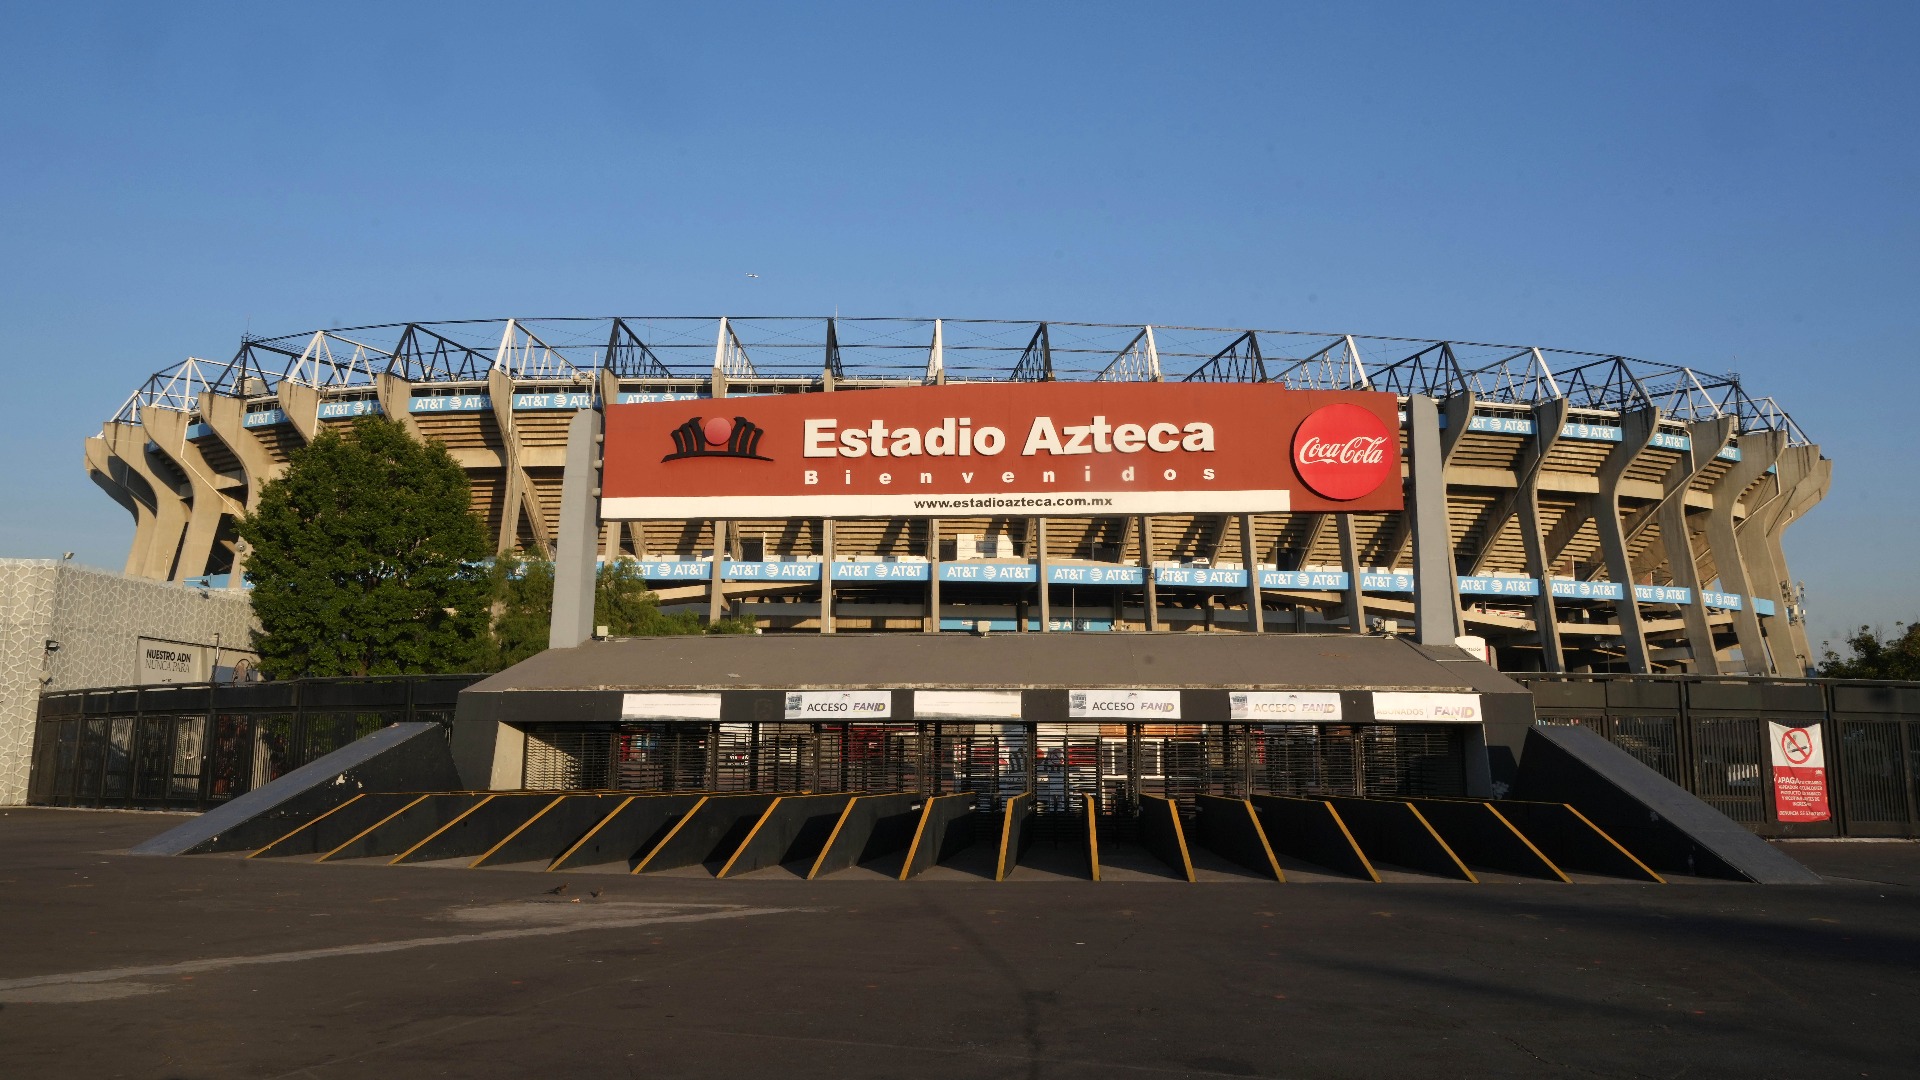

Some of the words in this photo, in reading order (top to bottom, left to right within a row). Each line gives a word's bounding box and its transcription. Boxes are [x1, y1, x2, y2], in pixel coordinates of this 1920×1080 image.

[415, 398, 446, 410] AT&T
[518, 395, 549, 407] AT&T
[323, 402, 351, 416] AT&T
[247, 412, 270, 425] AT&T
[1469, 418, 1487, 429] &T
[1504, 419, 1531, 432] AT&T
[803, 417, 1006, 458] Estadio
[1021, 415, 1215, 456] Azteca
[1561, 424, 1575, 436] &T
[1590, 427, 1615, 439] AT&T
[1665, 435, 1685, 448] AT&T
[1299, 436, 1388, 464] Coca-Cola
[1722, 447, 1737, 458] AT&T
[804, 465, 1215, 485] Bienvenidos
[914, 497, 1113, 509] www.estadioazteca.com.mx
[673, 563, 706, 576] AT&T
[728, 564, 761, 576] AT&T
[781, 564, 814, 577] AT&T
[838, 564, 870, 577] AT&T
[891, 564, 923, 577] AT&T
[947, 566, 980, 578] AT&T
[1000, 567, 1031, 579] AT&T
[1054, 568, 1086, 580] AT&T
[1105, 569, 1137, 581] AT&T
[1158, 569, 1190, 582] AT&T
[1209, 571, 1241, 584] AT&T
[1263, 573, 1294, 585] AT&T
[1312, 574, 1342, 586] AT&T
[1363, 575, 1392, 588] AT&T
[1460, 579, 1488, 591] AT&T
[1505, 580, 1532, 592] AT&T
[1552, 582, 1576, 594] AT&T
[1592, 584, 1617, 596] AT&T
[1666, 588, 1686, 600] AT&T
[1702, 592, 1713, 603] T&T
[1723, 595, 1738, 607] AT&T
[1063, 618, 1092, 630] AT&T
[146, 649, 175, 661] NUESTRO
[177, 652, 191, 662] ADN
[145, 659, 171, 671] NUNCA
[172, 661, 190, 672] PARA
[807, 703, 848, 712] ACCESO
[1092, 702, 1135, 711] ACCESO
[1253, 703, 1297, 713] ACCESO
[1376, 708, 1424, 716] ABONADOS
